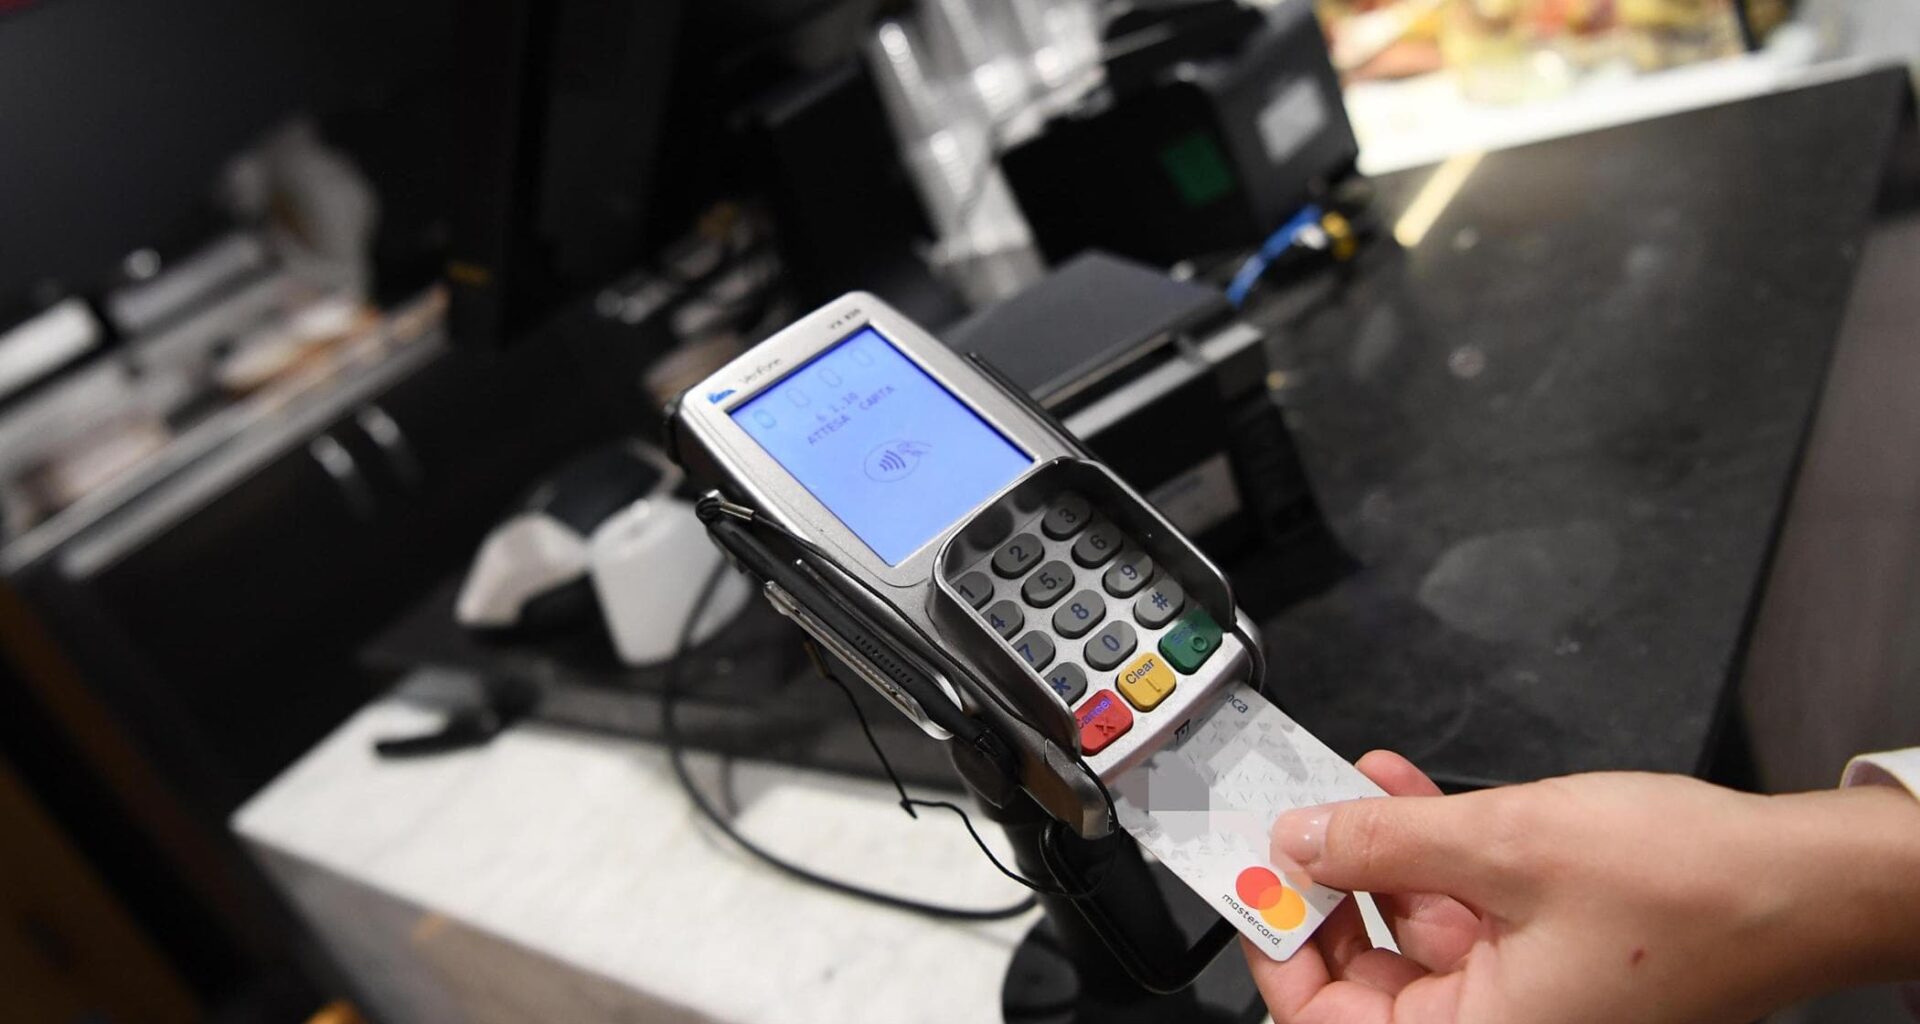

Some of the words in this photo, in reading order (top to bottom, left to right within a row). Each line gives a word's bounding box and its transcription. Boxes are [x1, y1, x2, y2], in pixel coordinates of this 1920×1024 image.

[807, 414, 851, 447] ATTESA
[960, 583, 976, 600] 1
[1008, 544, 1030, 563] 2
[1058, 507, 1078, 524] 3
[990, 612, 1007, 630] 4
[1089, 534, 1108, 551] 6
[1016, 642, 1035, 663] 7
[1070, 602, 1090, 621] 8
[1120, 563, 1138, 581] 9
[1101, 633, 1121, 653] 0
[1151, 590, 1169, 612] #
[1125, 658, 1155, 685] Clear
[1221, 893, 1282, 947] mastercard
